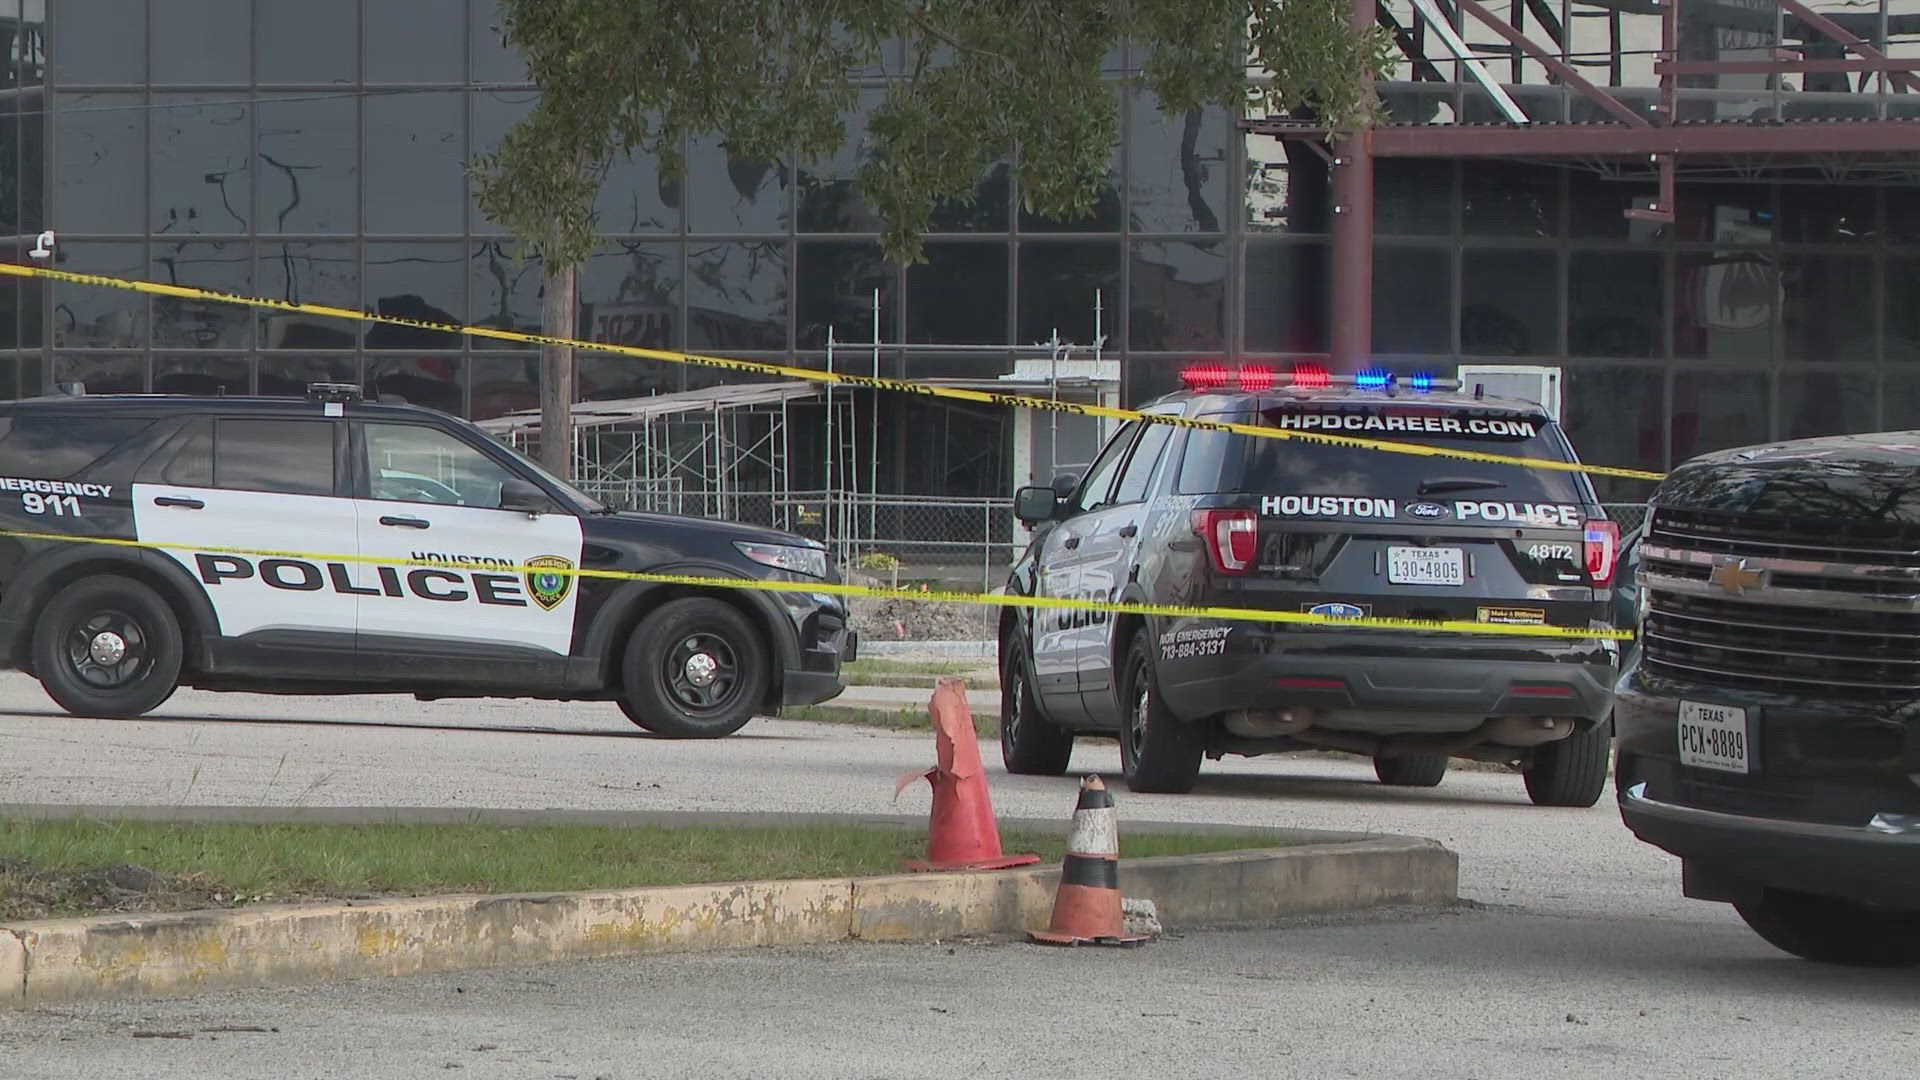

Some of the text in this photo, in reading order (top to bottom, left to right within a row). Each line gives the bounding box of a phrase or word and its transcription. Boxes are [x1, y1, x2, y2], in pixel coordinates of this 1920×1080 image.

[1280, 414, 1537, 438] HPDCAREER.COM
[22, 492, 81, 517] 911
[1261, 496, 1579, 526] HOUSTON POLICE
[1414, 504, 1440, 517] Ford
[1152, 511, 1180, 537] 911
[1411, 550, 1440, 558] TEXAS
[1528, 544, 1573, 560] 48172
[194, 553, 528, 608] POLICE
[1159, 627, 1233, 645] NON EMERGENCY
[1161, 639, 1227, 660] 713-884-3131
[1698, 708, 1724, 722] TEXAS
